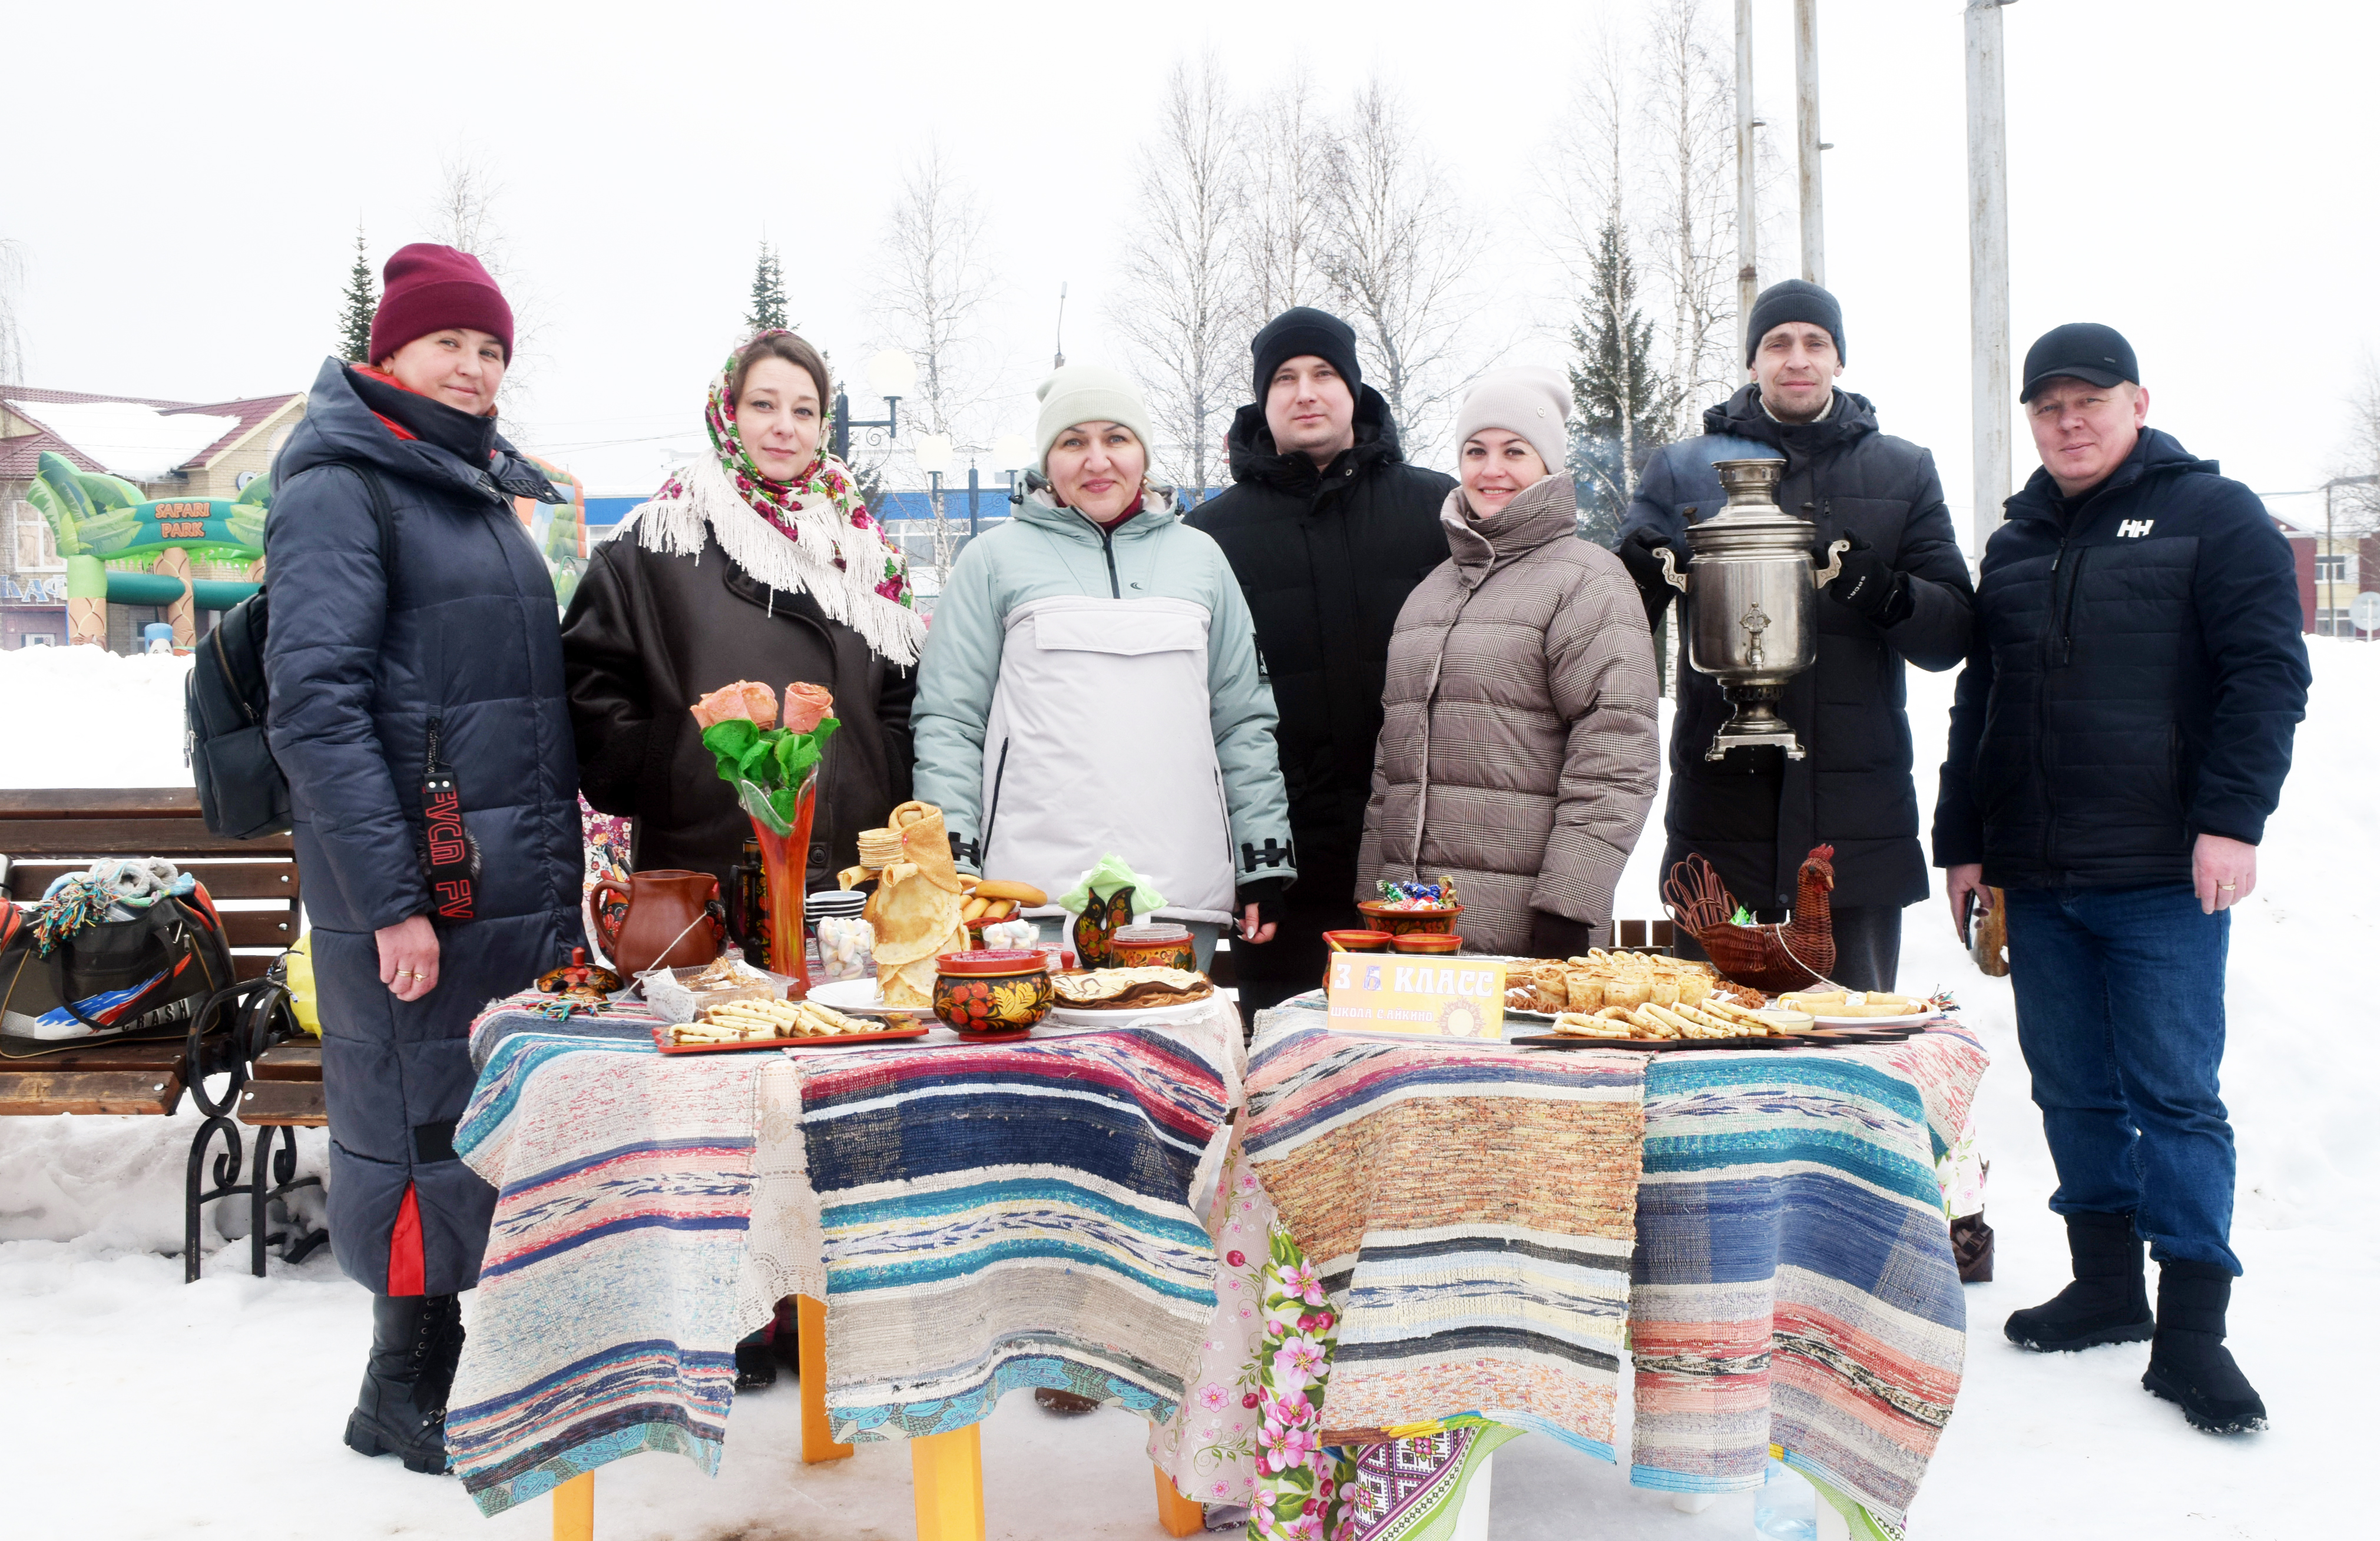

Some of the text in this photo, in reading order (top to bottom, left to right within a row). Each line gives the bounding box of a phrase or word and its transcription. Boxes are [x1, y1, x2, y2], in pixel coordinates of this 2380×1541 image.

[155, 502, 211, 519] SAFARI
[161, 521, 205, 539] PARK
[2116, 519, 2154, 538] HH
[1334, 963, 1352, 989] 3
[1393, 966, 1495, 997] КЛАСС
[1330, 1006, 1373, 1019] ШКОЛА
